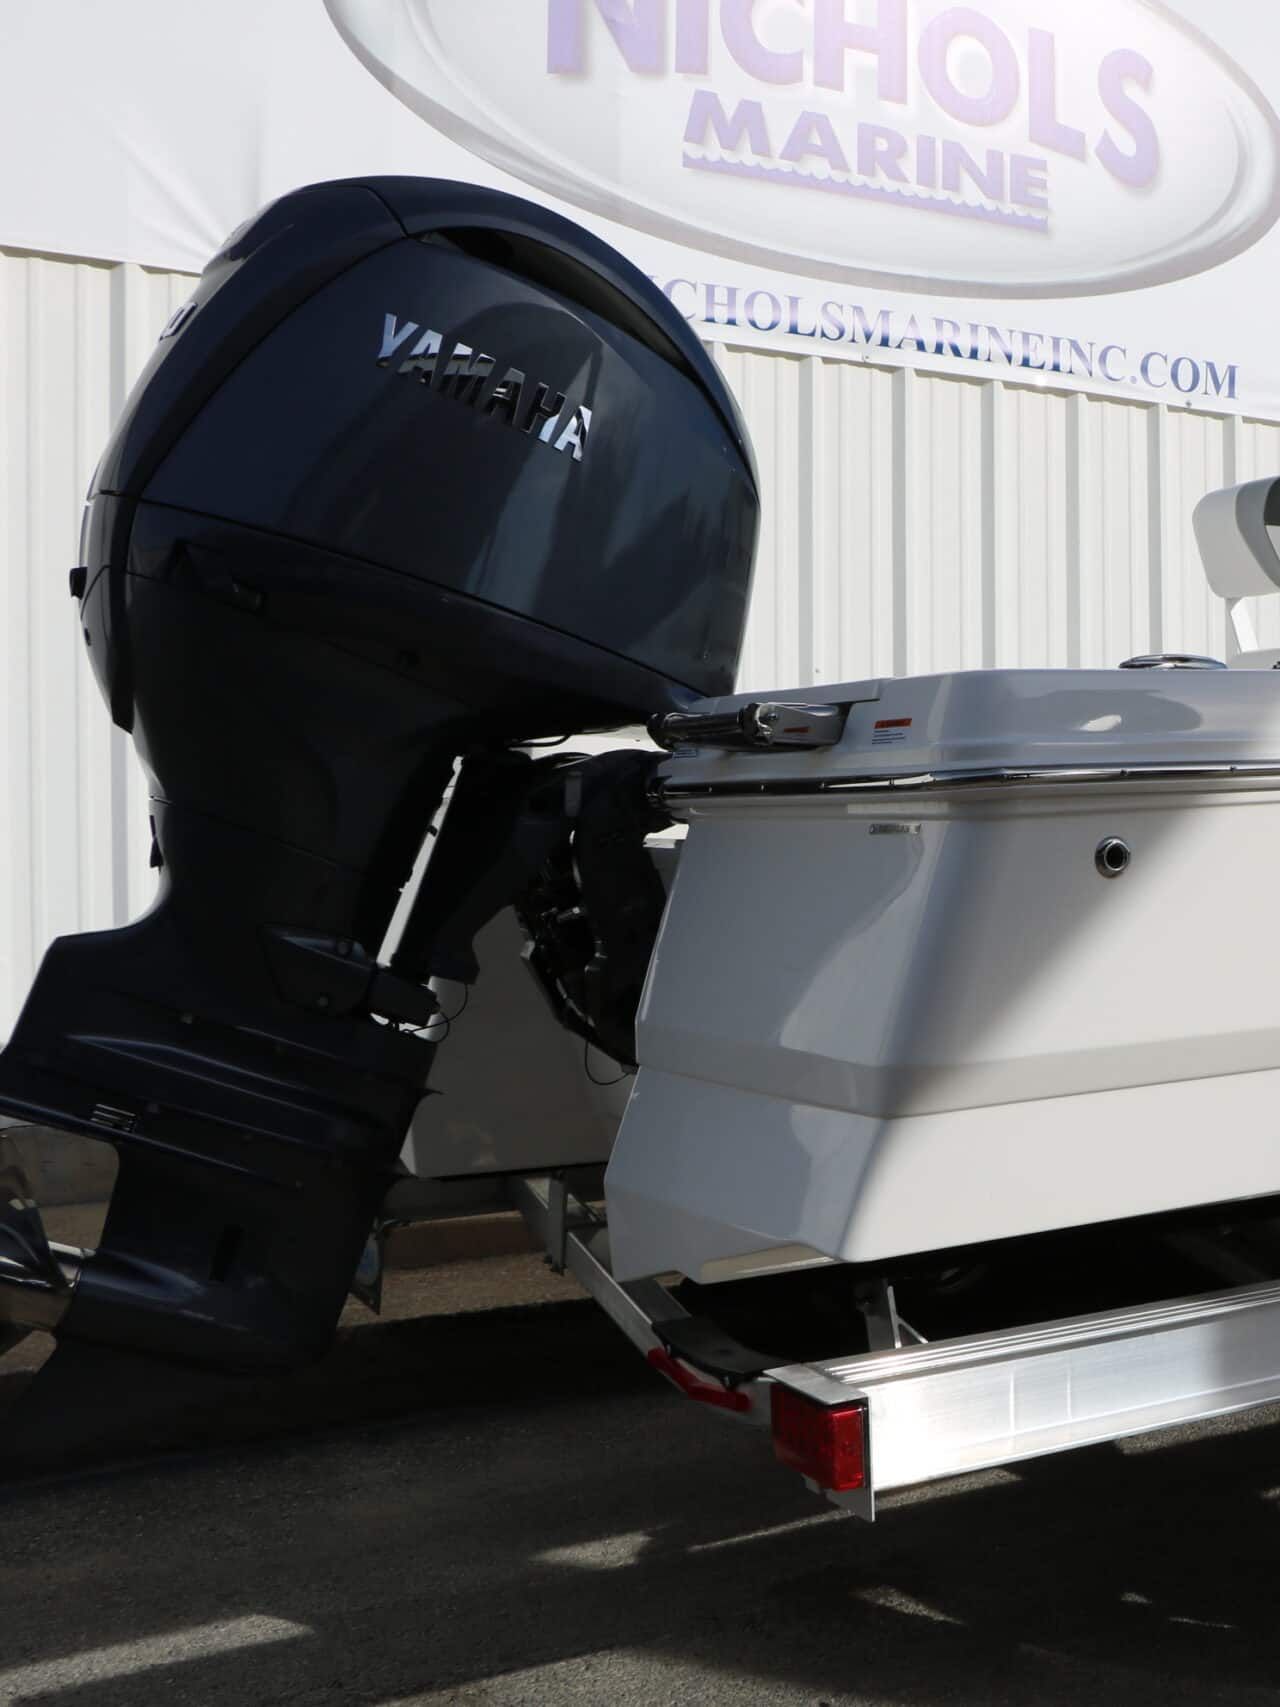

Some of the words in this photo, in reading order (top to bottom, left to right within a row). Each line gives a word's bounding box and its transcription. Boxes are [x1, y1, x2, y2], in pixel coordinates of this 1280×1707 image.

[547, 0, 1160, 188] NICHOLS
[682, 89, 1048, 209] MARINE
[376, 313, 592, 462] YAMAHA
[648, 275, 1239, 399] CHOLSMARINEINC.COM
